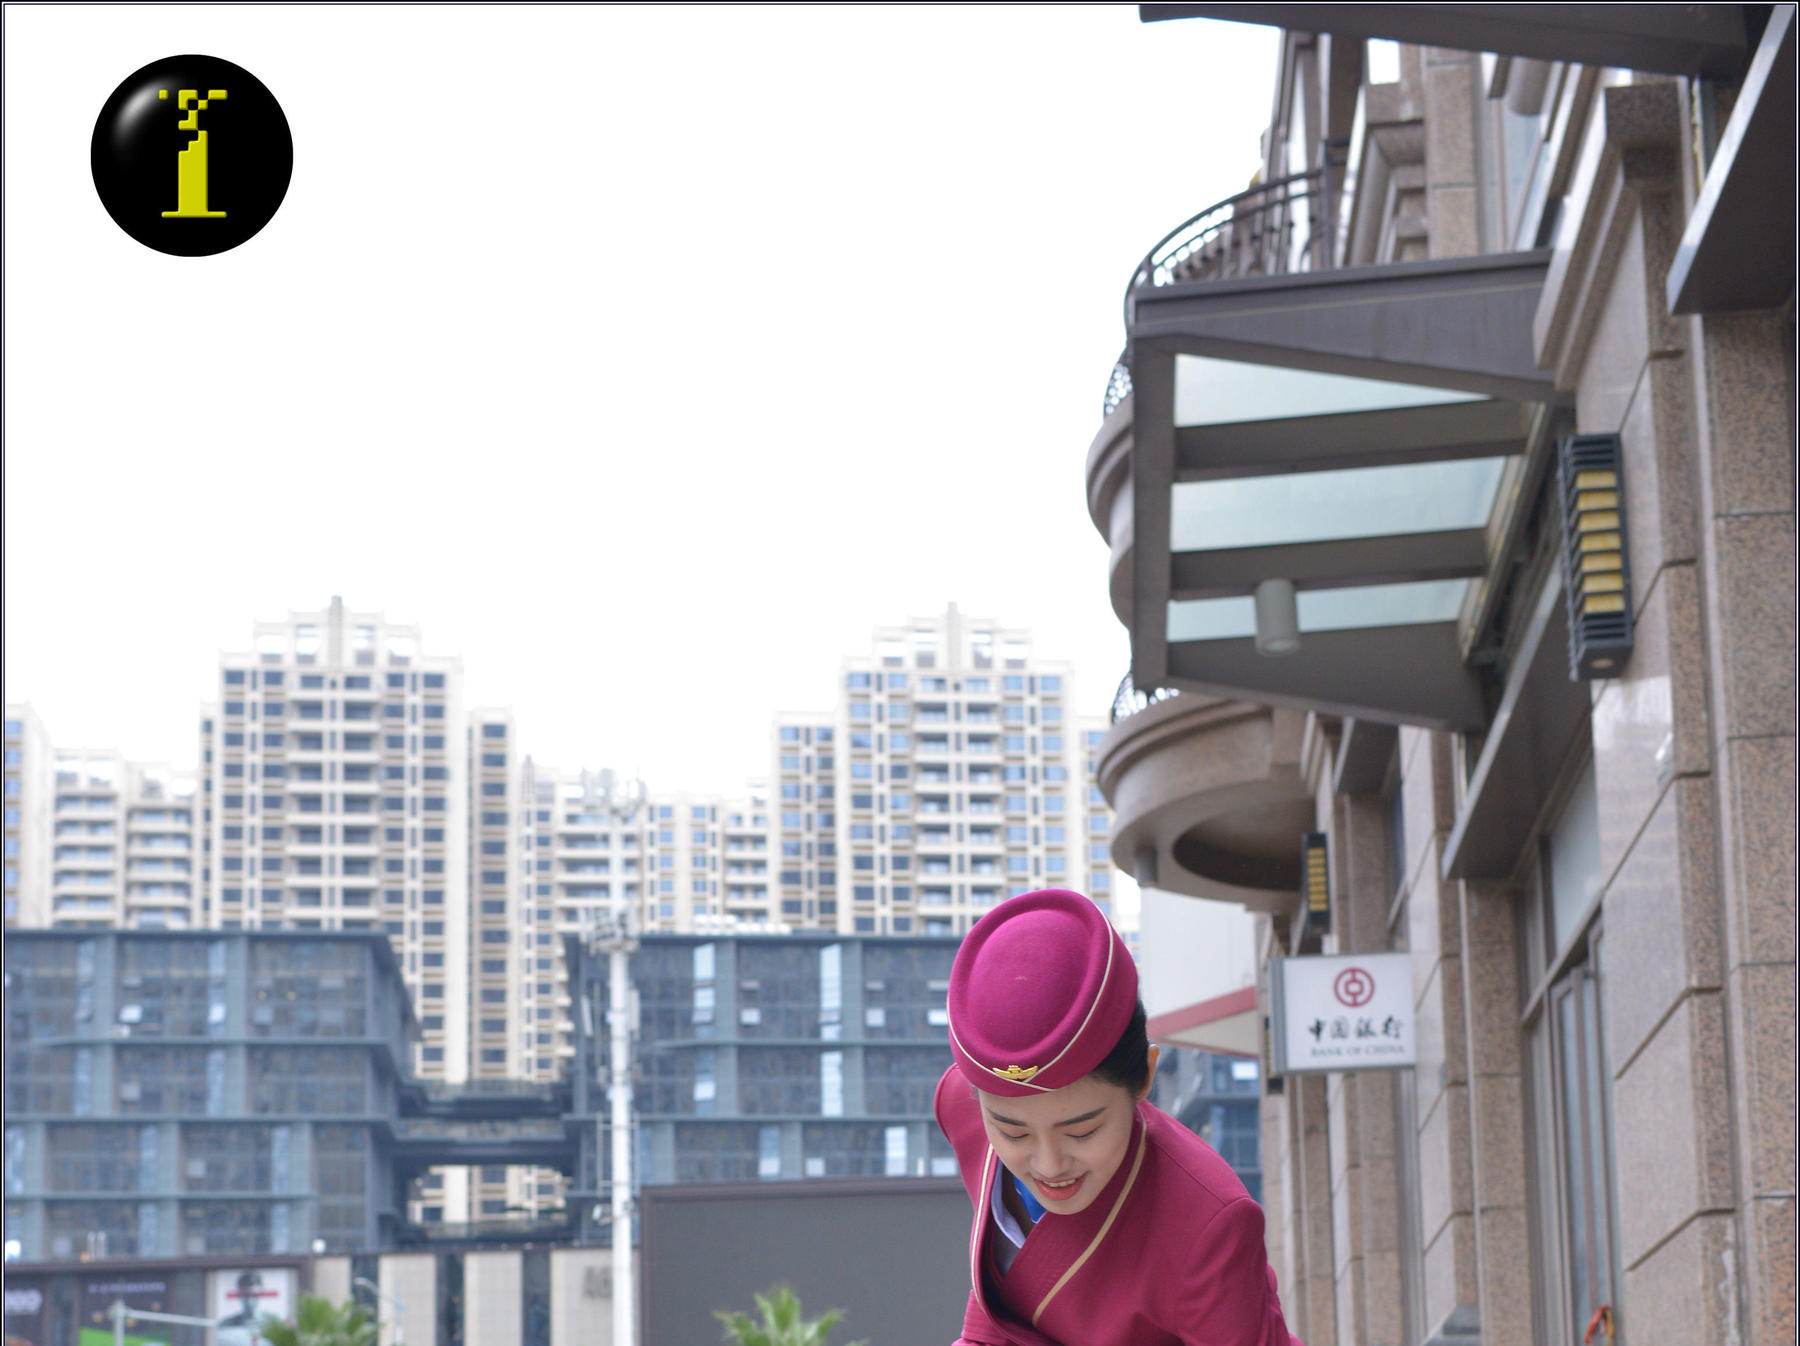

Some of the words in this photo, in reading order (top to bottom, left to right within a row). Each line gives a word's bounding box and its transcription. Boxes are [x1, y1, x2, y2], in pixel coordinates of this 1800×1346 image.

[1307, 1015, 1403, 1042] 中国银行
[1310, 1046, 1342, 1058] BANK
[1347, 1045, 1362, 1056] OF
[1365, 1044, 1405, 1056] CHINA
